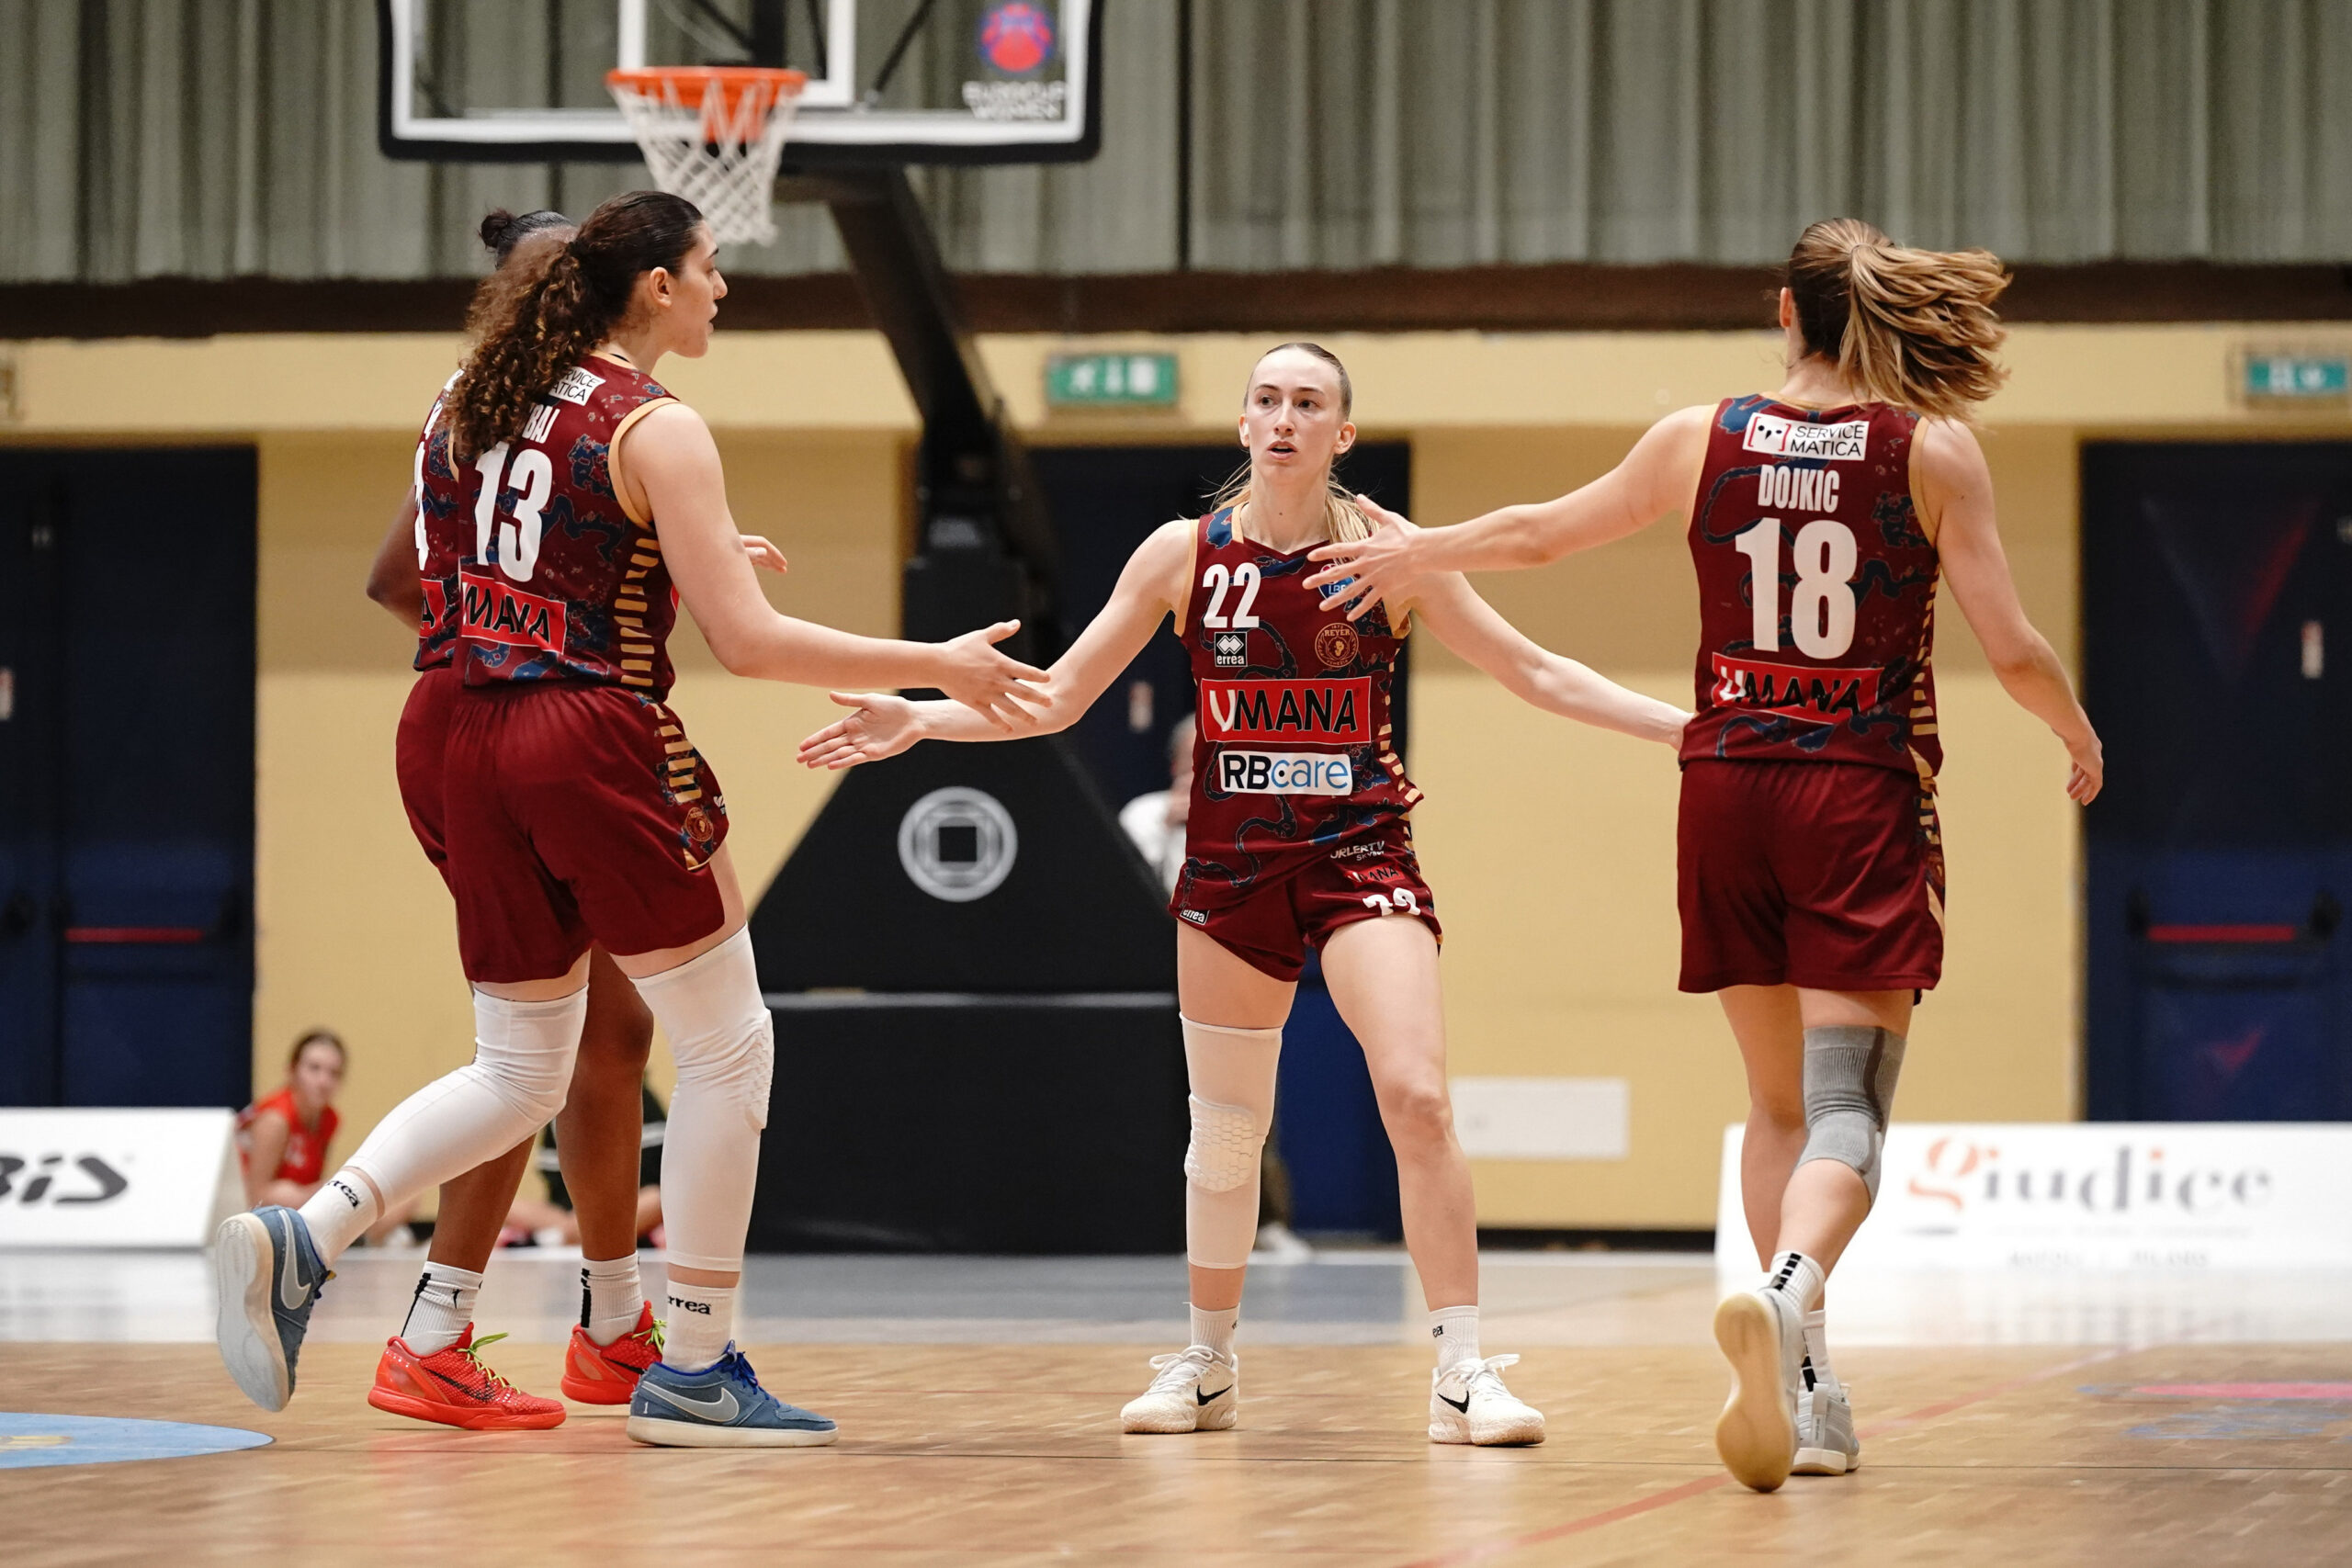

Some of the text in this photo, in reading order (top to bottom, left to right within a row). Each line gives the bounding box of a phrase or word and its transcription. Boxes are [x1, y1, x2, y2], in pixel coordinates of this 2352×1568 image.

[552, 382, 586, 401] ATICA
[564, 369, 601, 388] RVICE
[1790, 439, 1861, 457] MATICA
[1795, 424, 1865, 439] SERVICE
[1758, 465, 1839, 513] DOJKIC
[474, 441, 552, 582] 13
[1203, 562, 1261, 628] 22
[1736, 517, 1858, 660] 18
[461, 582, 551, 644] MANA
[1324, 628, 1351, 637] REYER
[1216, 655, 1245, 665] errea
[1209, 688, 1358, 733] UMANA
[1719, 666, 1861, 716] UMANA
[1224, 754, 1349, 790] RBcare
[1907, 1137, 2271, 1212] giudice
[668, 1295, 712, 1315] rrea
